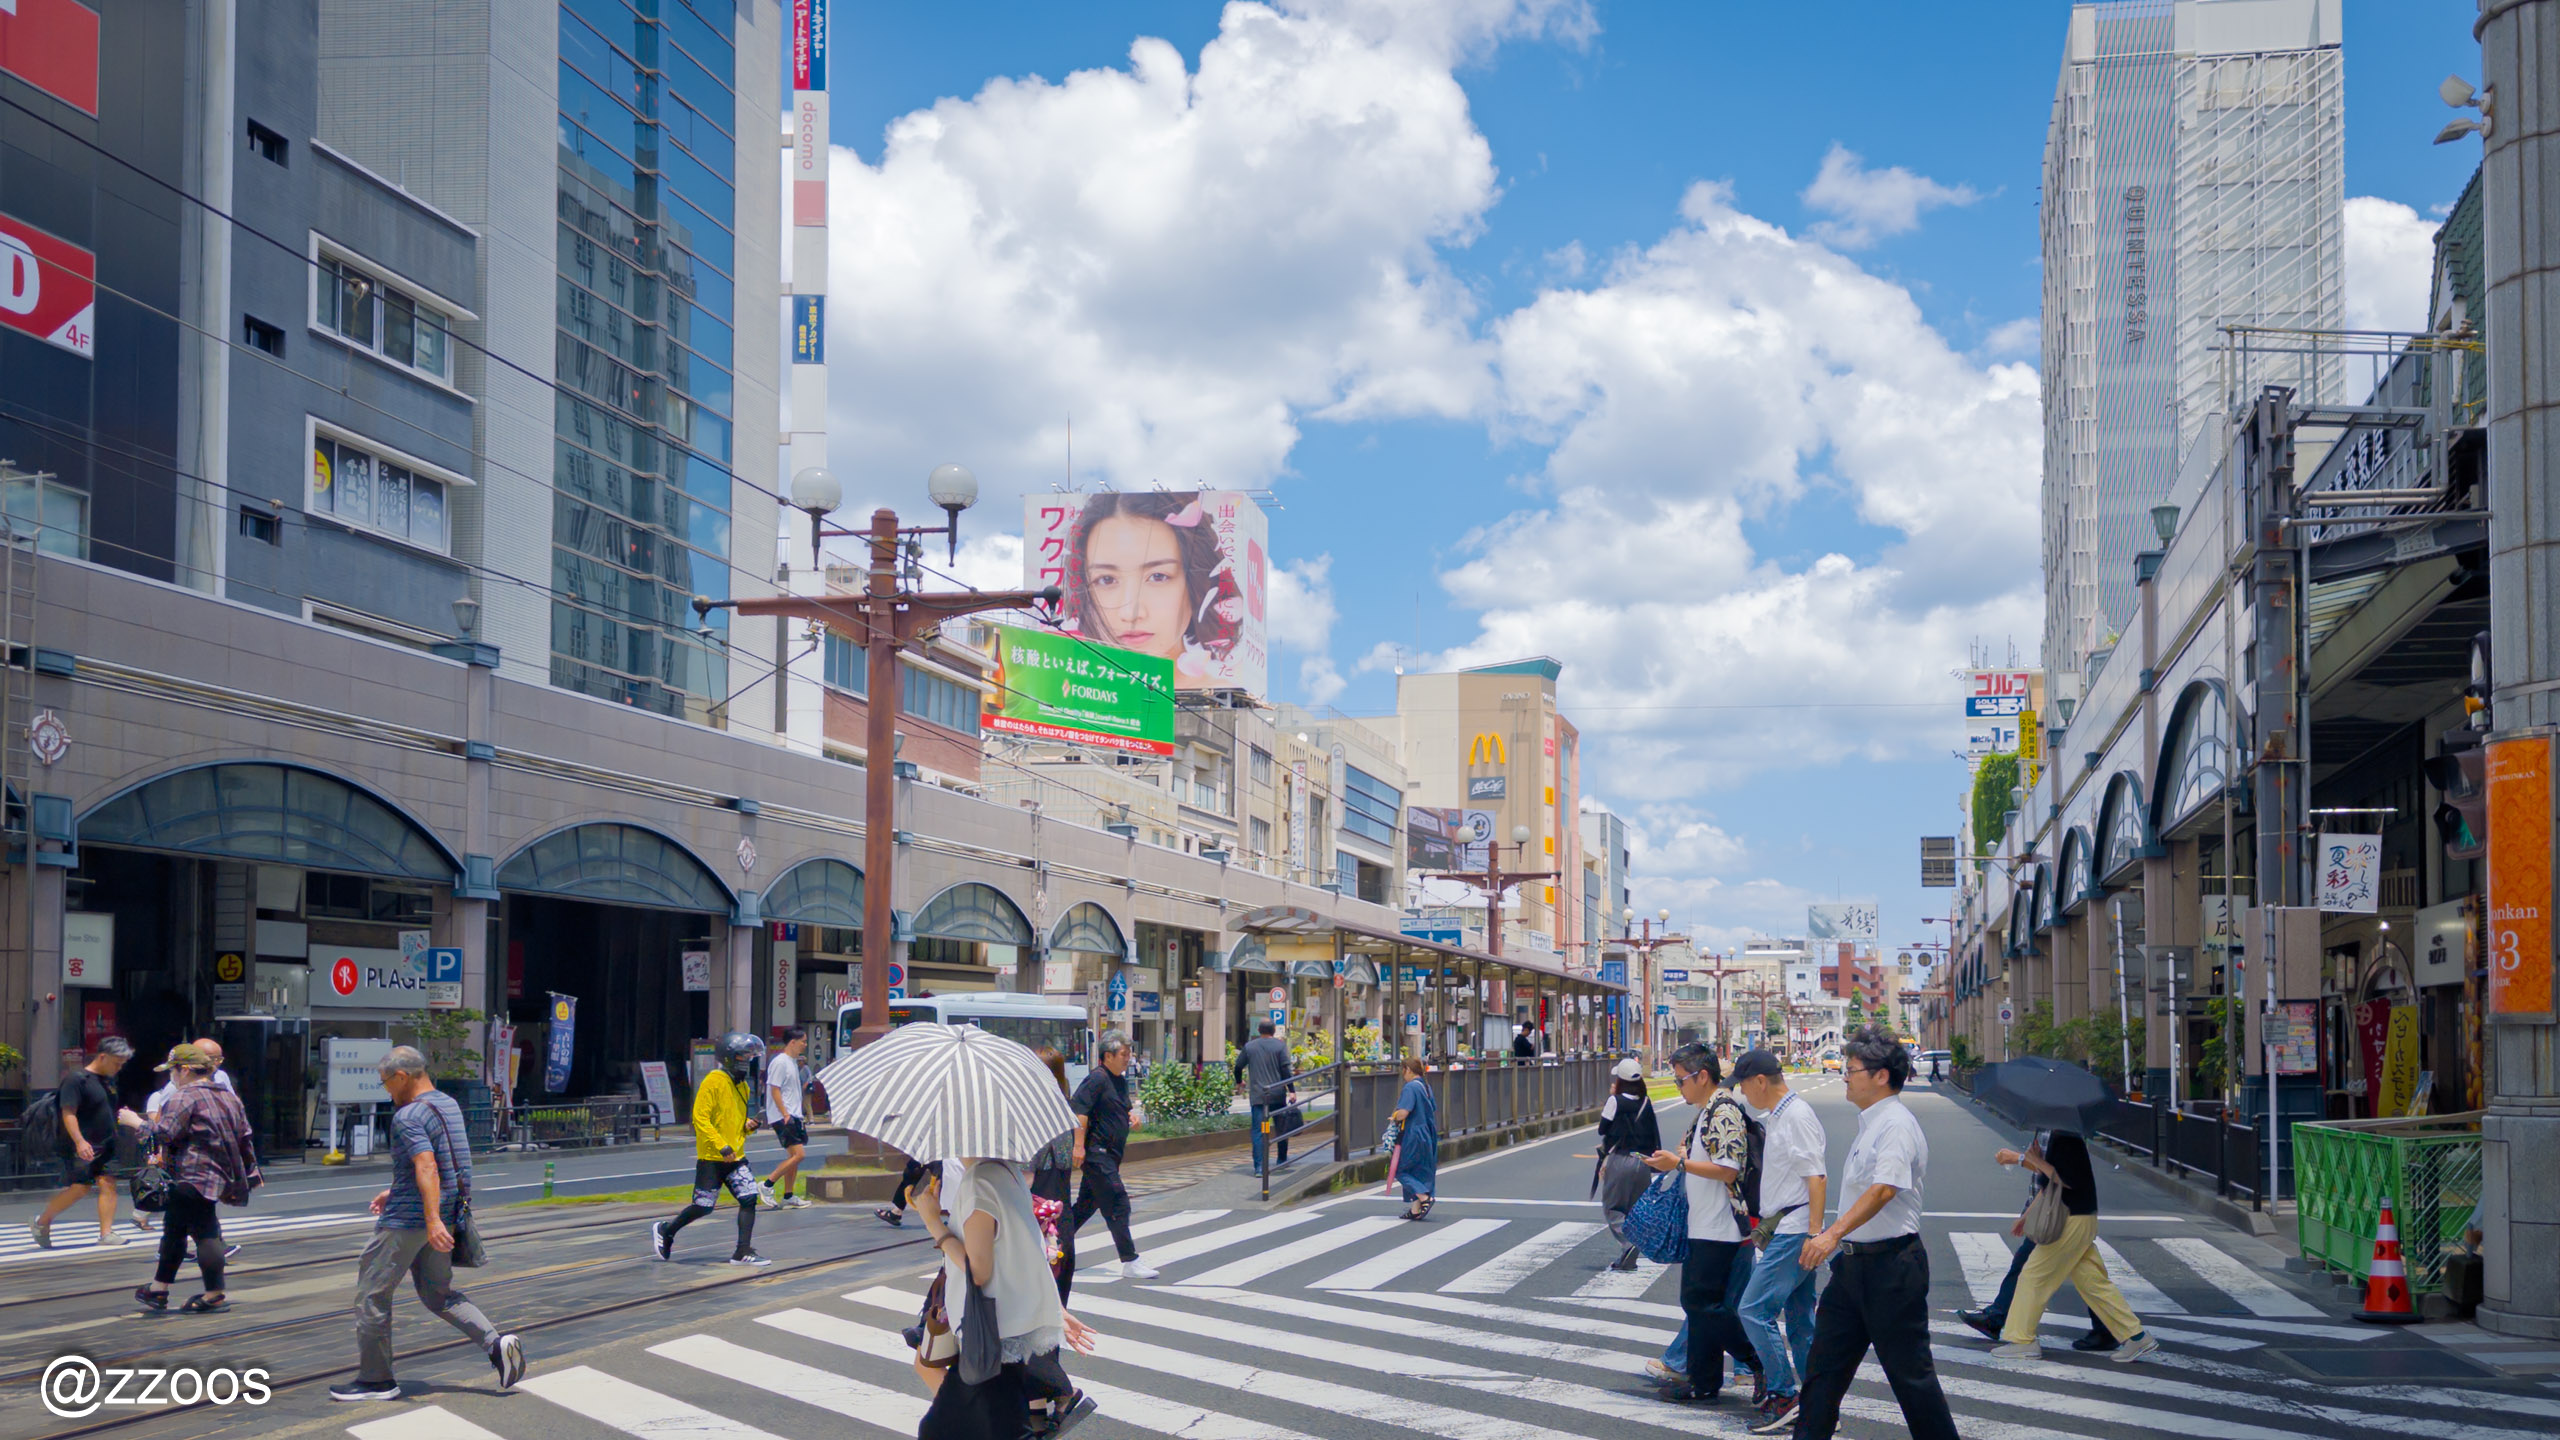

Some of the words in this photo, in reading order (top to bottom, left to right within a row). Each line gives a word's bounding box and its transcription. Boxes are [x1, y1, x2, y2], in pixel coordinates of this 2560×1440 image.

[802, 101, 816, 170] docomo
[2123, 185, 2147, 343] QUINTESSA
[65, 324, 90, 350] 4F
[1068, 505, 1083, 623] わたしをひらく
[1217, 504, 1236, 678] 出会いで、世界に色がついた
[1011, 644, 1167, 692] 核酸といえば、フォーデイズ。
[1072, 683, 1119, 704] FORDAYS
[1975, 673, 2029, 696] ゴルフ
[1991, 727, 2015, 743] 1F
[222, 954, 239, 978] 占
[436, 951, 456, 979] P
[778, 959, 790, 1008] docomo
[1273, 1010, 1283, 1024] P
[1409, 1015, 1417, 1025] P
